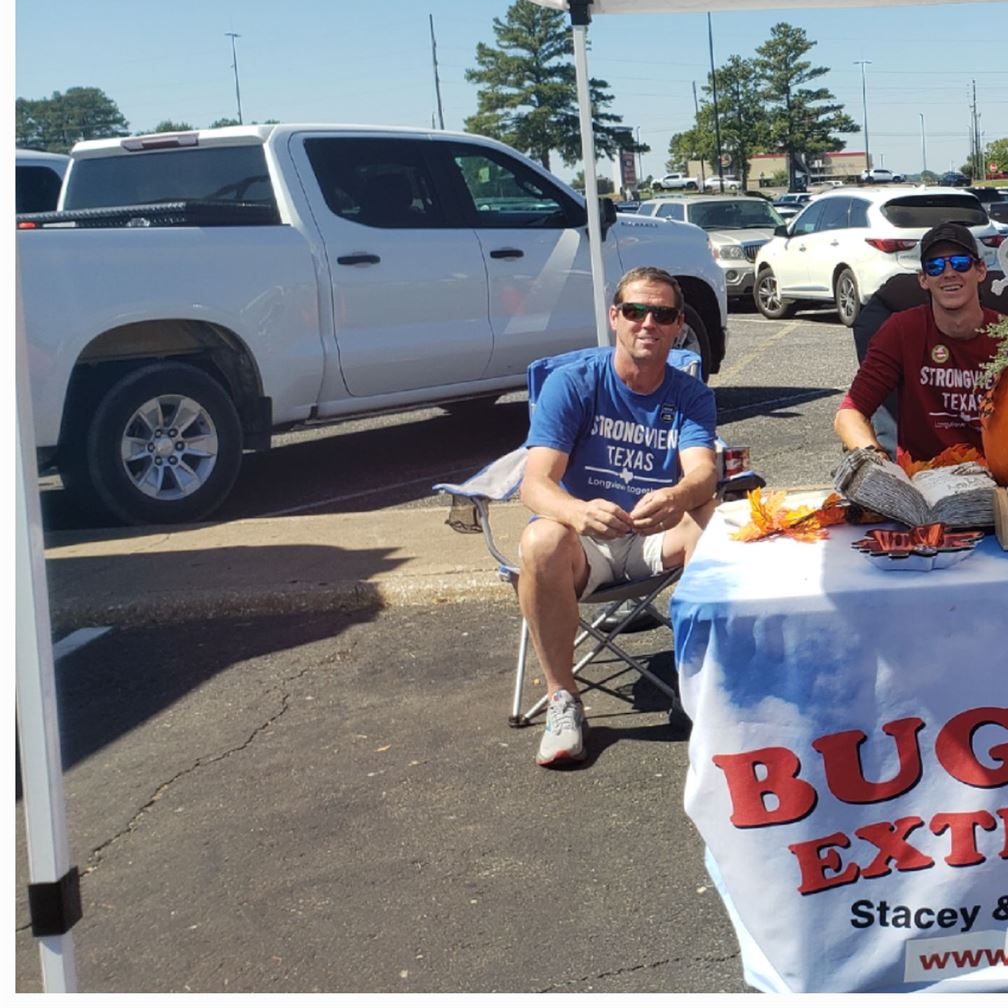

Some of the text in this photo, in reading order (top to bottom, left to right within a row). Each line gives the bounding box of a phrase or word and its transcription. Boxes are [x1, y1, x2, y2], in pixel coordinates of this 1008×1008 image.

[607, 445, 654, 471] TEXAS
[588, 477, 626, 491] Longview
[851, 900, 980, 932] Stacey
